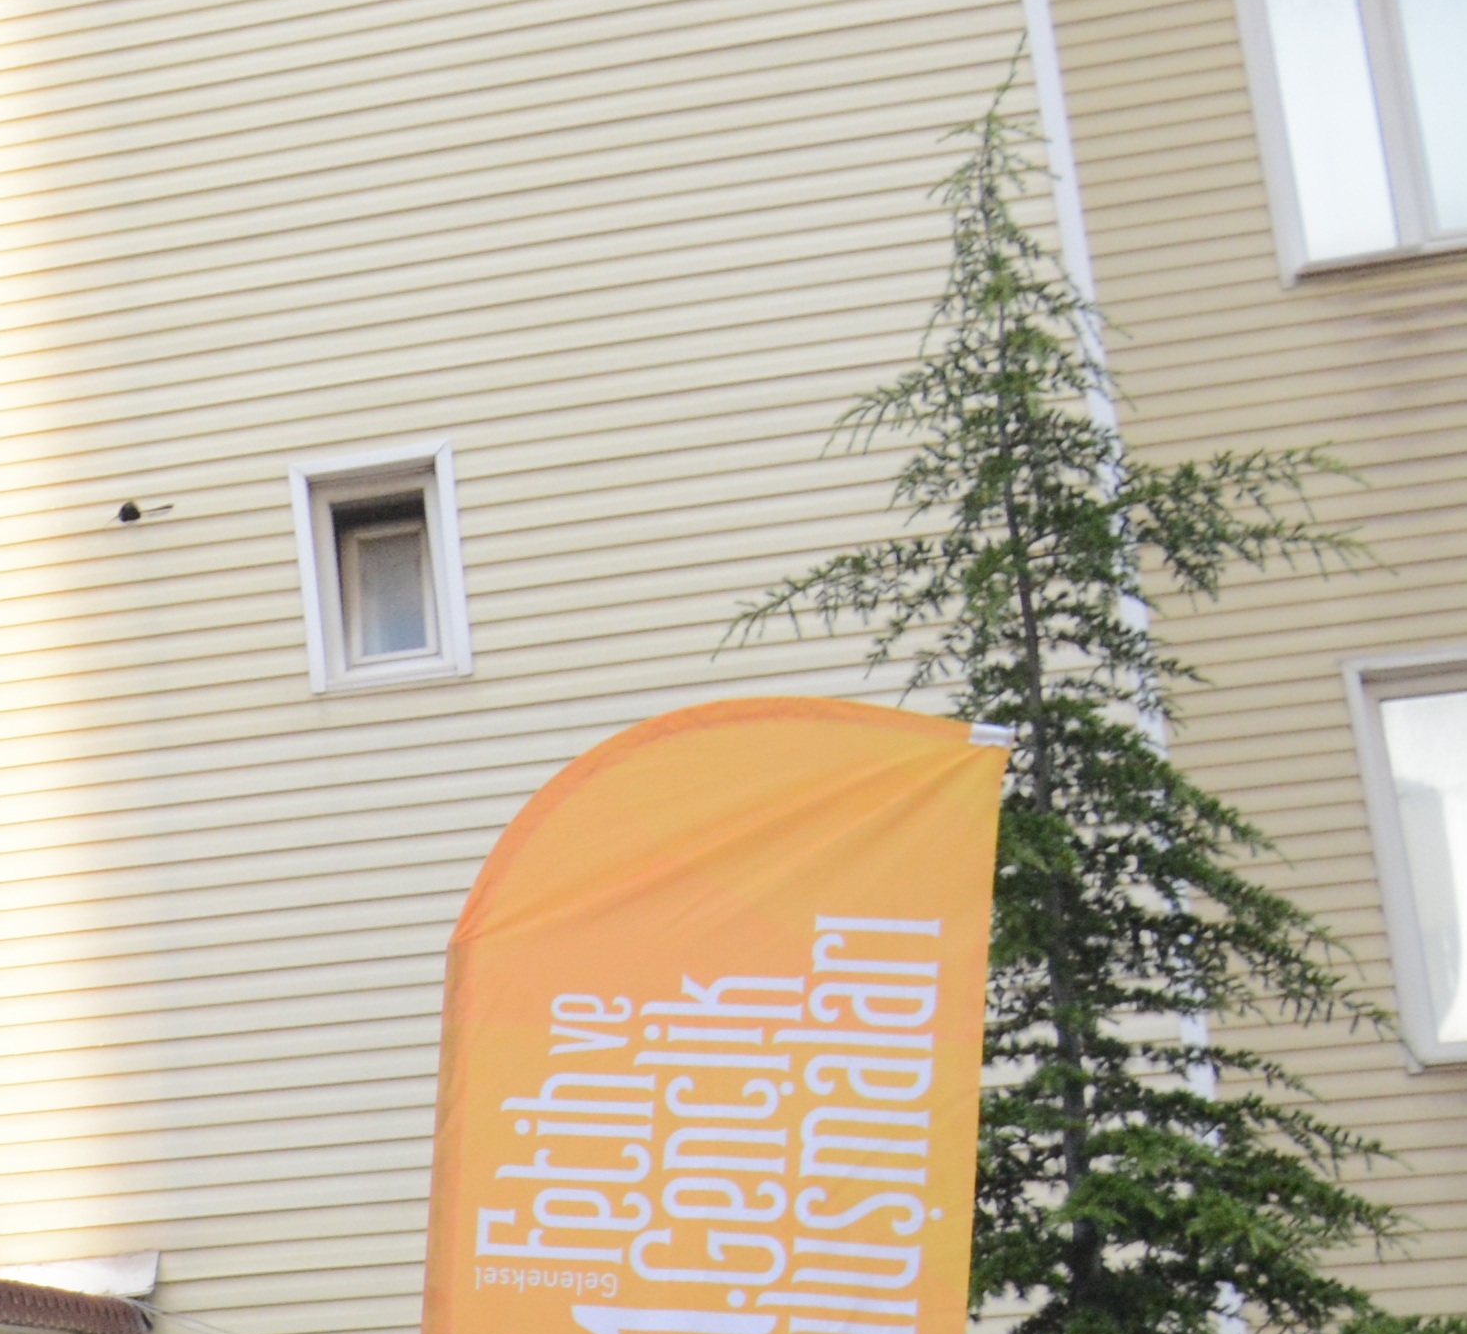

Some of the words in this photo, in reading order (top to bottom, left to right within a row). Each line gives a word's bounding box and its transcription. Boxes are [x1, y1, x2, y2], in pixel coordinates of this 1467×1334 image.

[549, 993, 633, 1055] ve
[476, 1073, 656, 1263] Fetih
[474, 1265, 619, 1298] Geleneksel
